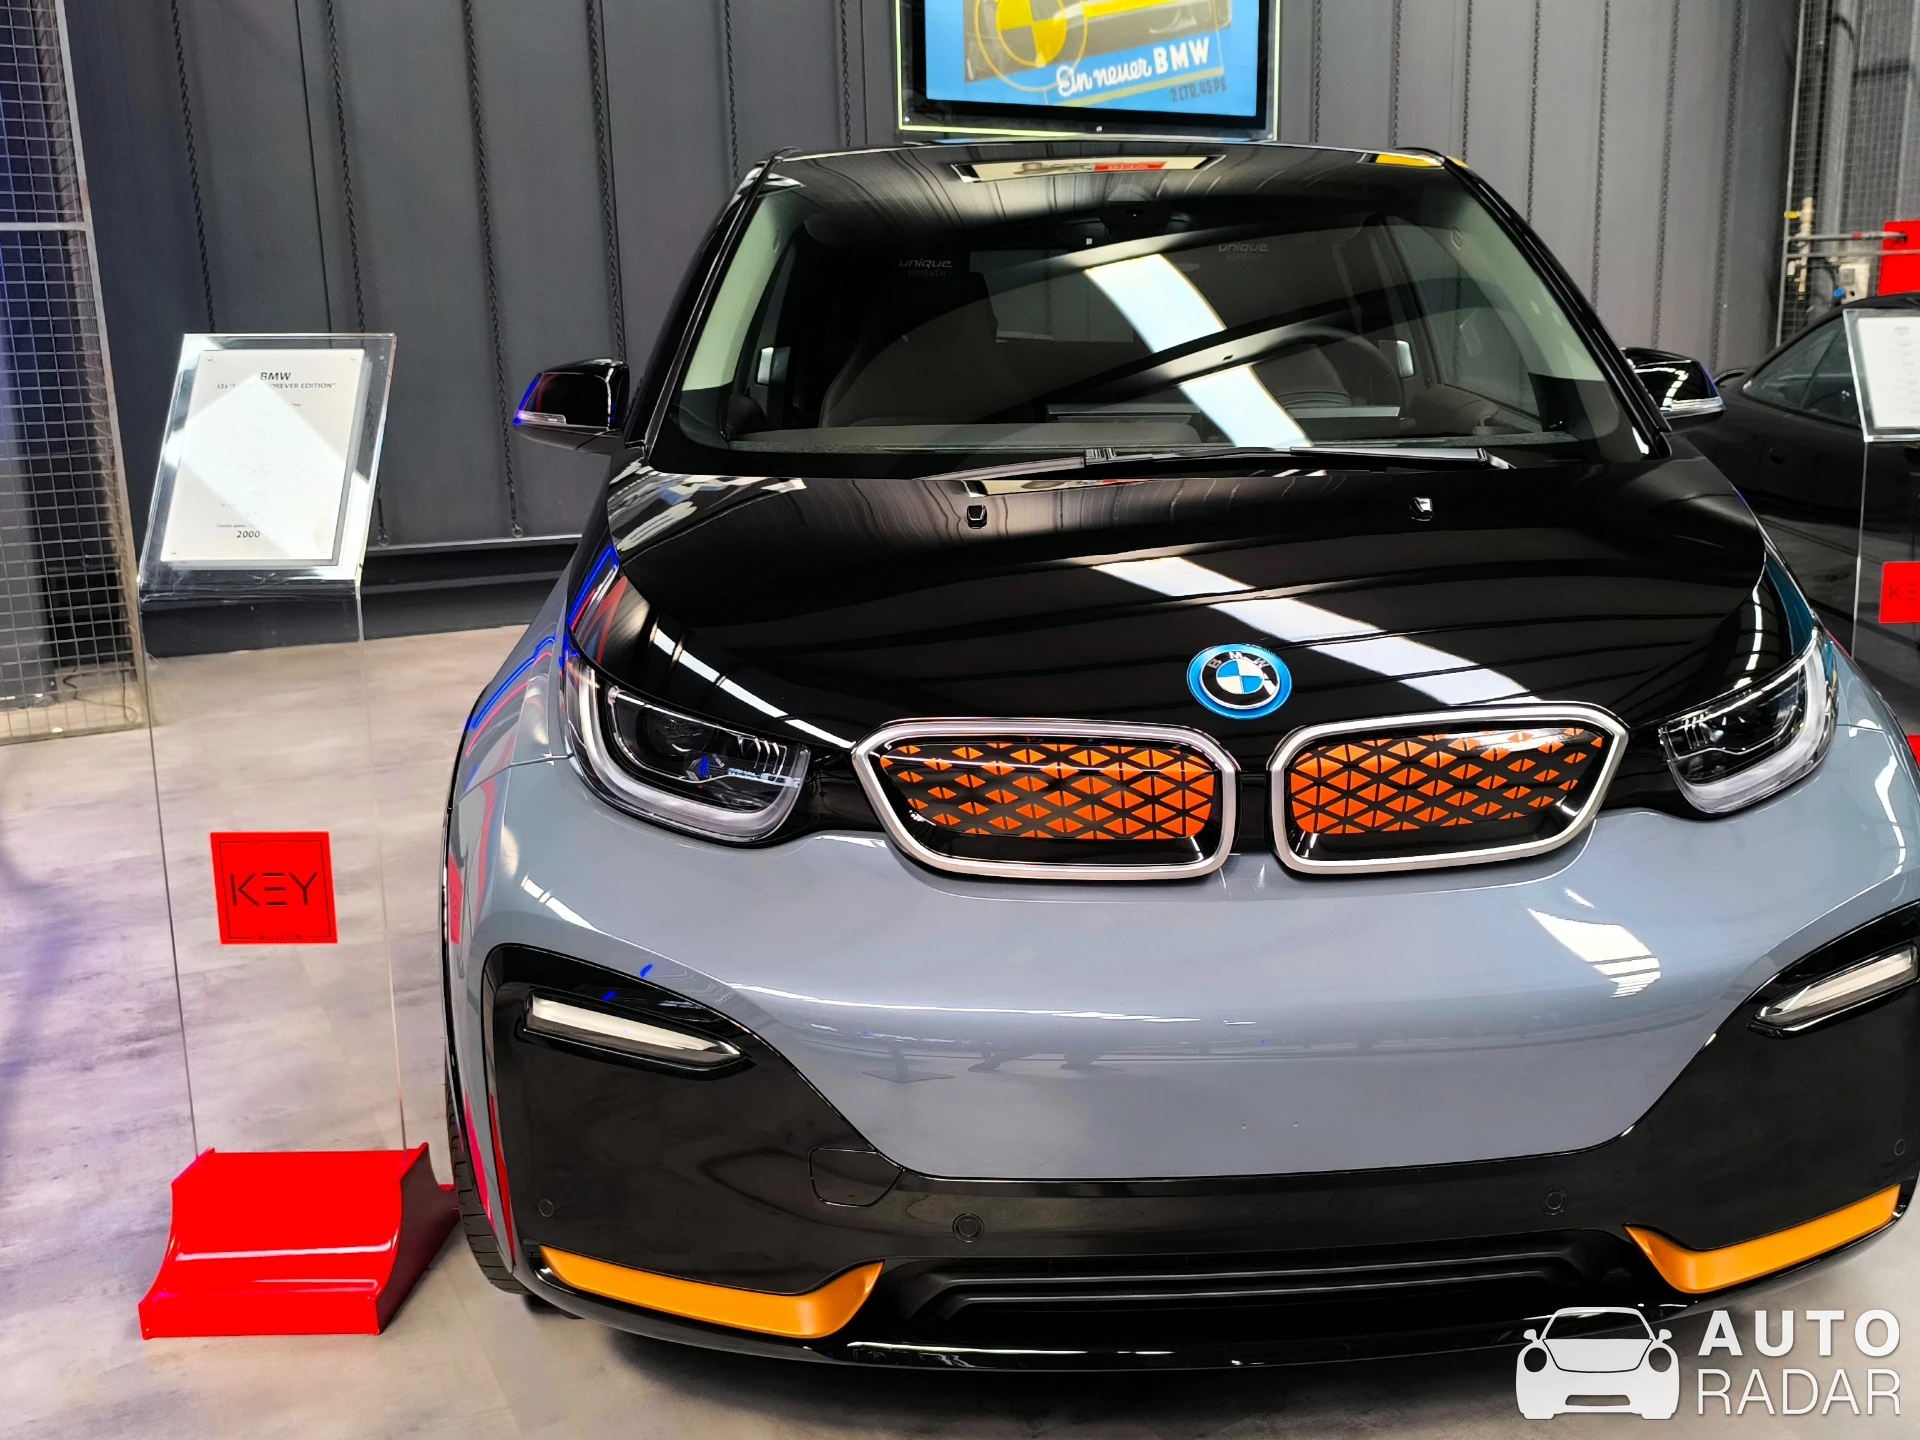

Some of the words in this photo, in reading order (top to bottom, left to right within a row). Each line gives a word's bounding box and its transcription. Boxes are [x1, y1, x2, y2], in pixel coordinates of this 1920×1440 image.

[1056, 65, 1093, 97] Ein
[1093, 57, 1152, 87] neuer
[1153, 36, 1210, 75] BMW
[1218, 242, 1269, 253] unique
[898, 258, 953, 269] unique
[260, 372, 292, 380] BMW
[236, 530, 260, 538] 2000
[1888, 582, 1918, 601] KE
[1207, 651, 1270, 669] BMW
[230, 872, 319, 906] KEY
